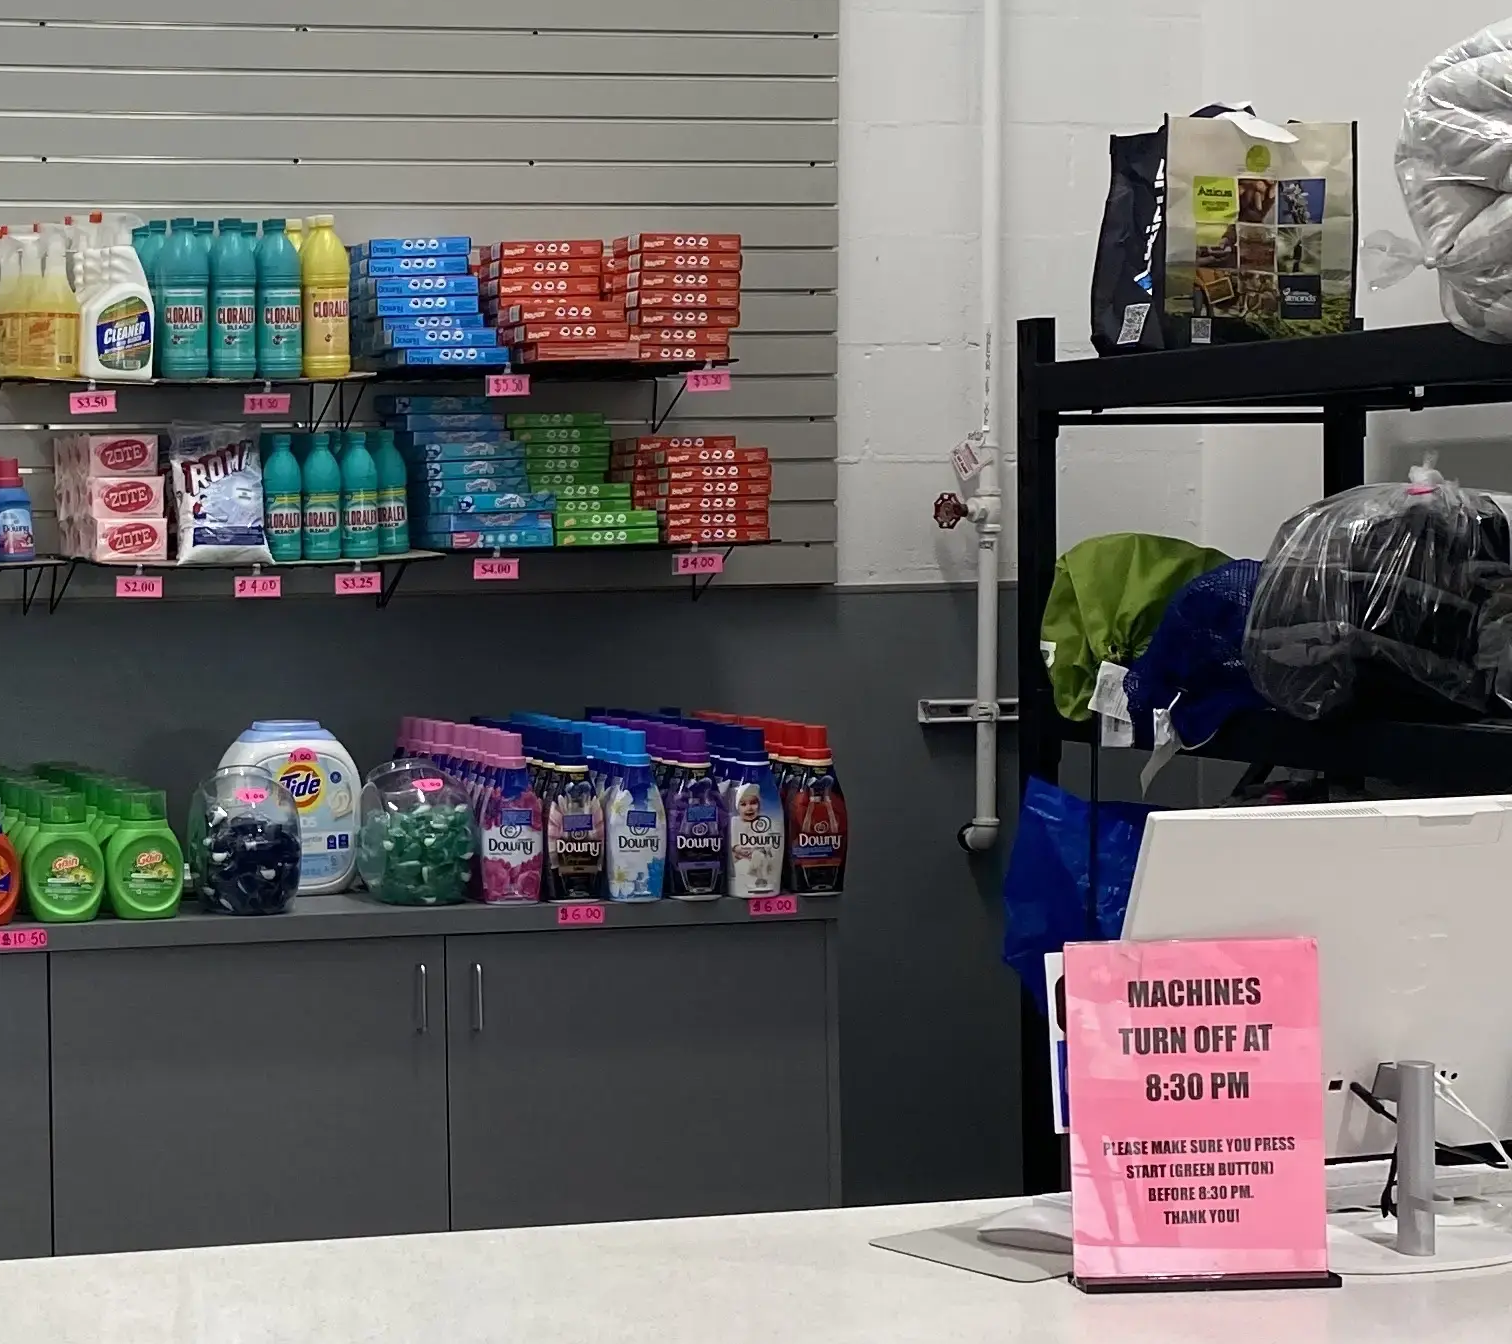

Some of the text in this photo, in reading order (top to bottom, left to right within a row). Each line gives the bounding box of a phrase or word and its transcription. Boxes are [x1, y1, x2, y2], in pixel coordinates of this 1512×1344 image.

[104, 322, 145, 344] CLEANER
[78, 396, 107, 408] $3.50
[105, 445, 143, 465] ZOTE
[110, 487, 148, 507] ZOTE
[114, 528, 152, 548] ZOTE
[481, 563, 510, 575] $4.00
[124, 581, 155, 593] $2.00
[343, 577, 373, 589] $3.25
[278, 773, 321, 798] Tide
[489, 838, 535, 855] Downy
[556, 839, 602, 857] Downy
[618, 835, 661, 852] Downy
[677, 835, 724, 852] Downy
[739, 833, 784, 850] Downy
[799, 832, 843, 849] Downy
[1127, 977, 1262, 1008] MACHINES
[1118, 1023, 1273, 1055] TURN OFF AT
[1145, 1071, 1250, 1102] 8:30 PM
[1103, 1136, 1295, 1156] PLEASE MAKE SURE YOU PRESS
[1126, 1160, 1274, 1179] START (GREEN BUTTON)
[1148, 1185, 1255, 1202] BEFORE 8:30 PM.
[1164, 1208, 1240, 1225] THANK YOU!
